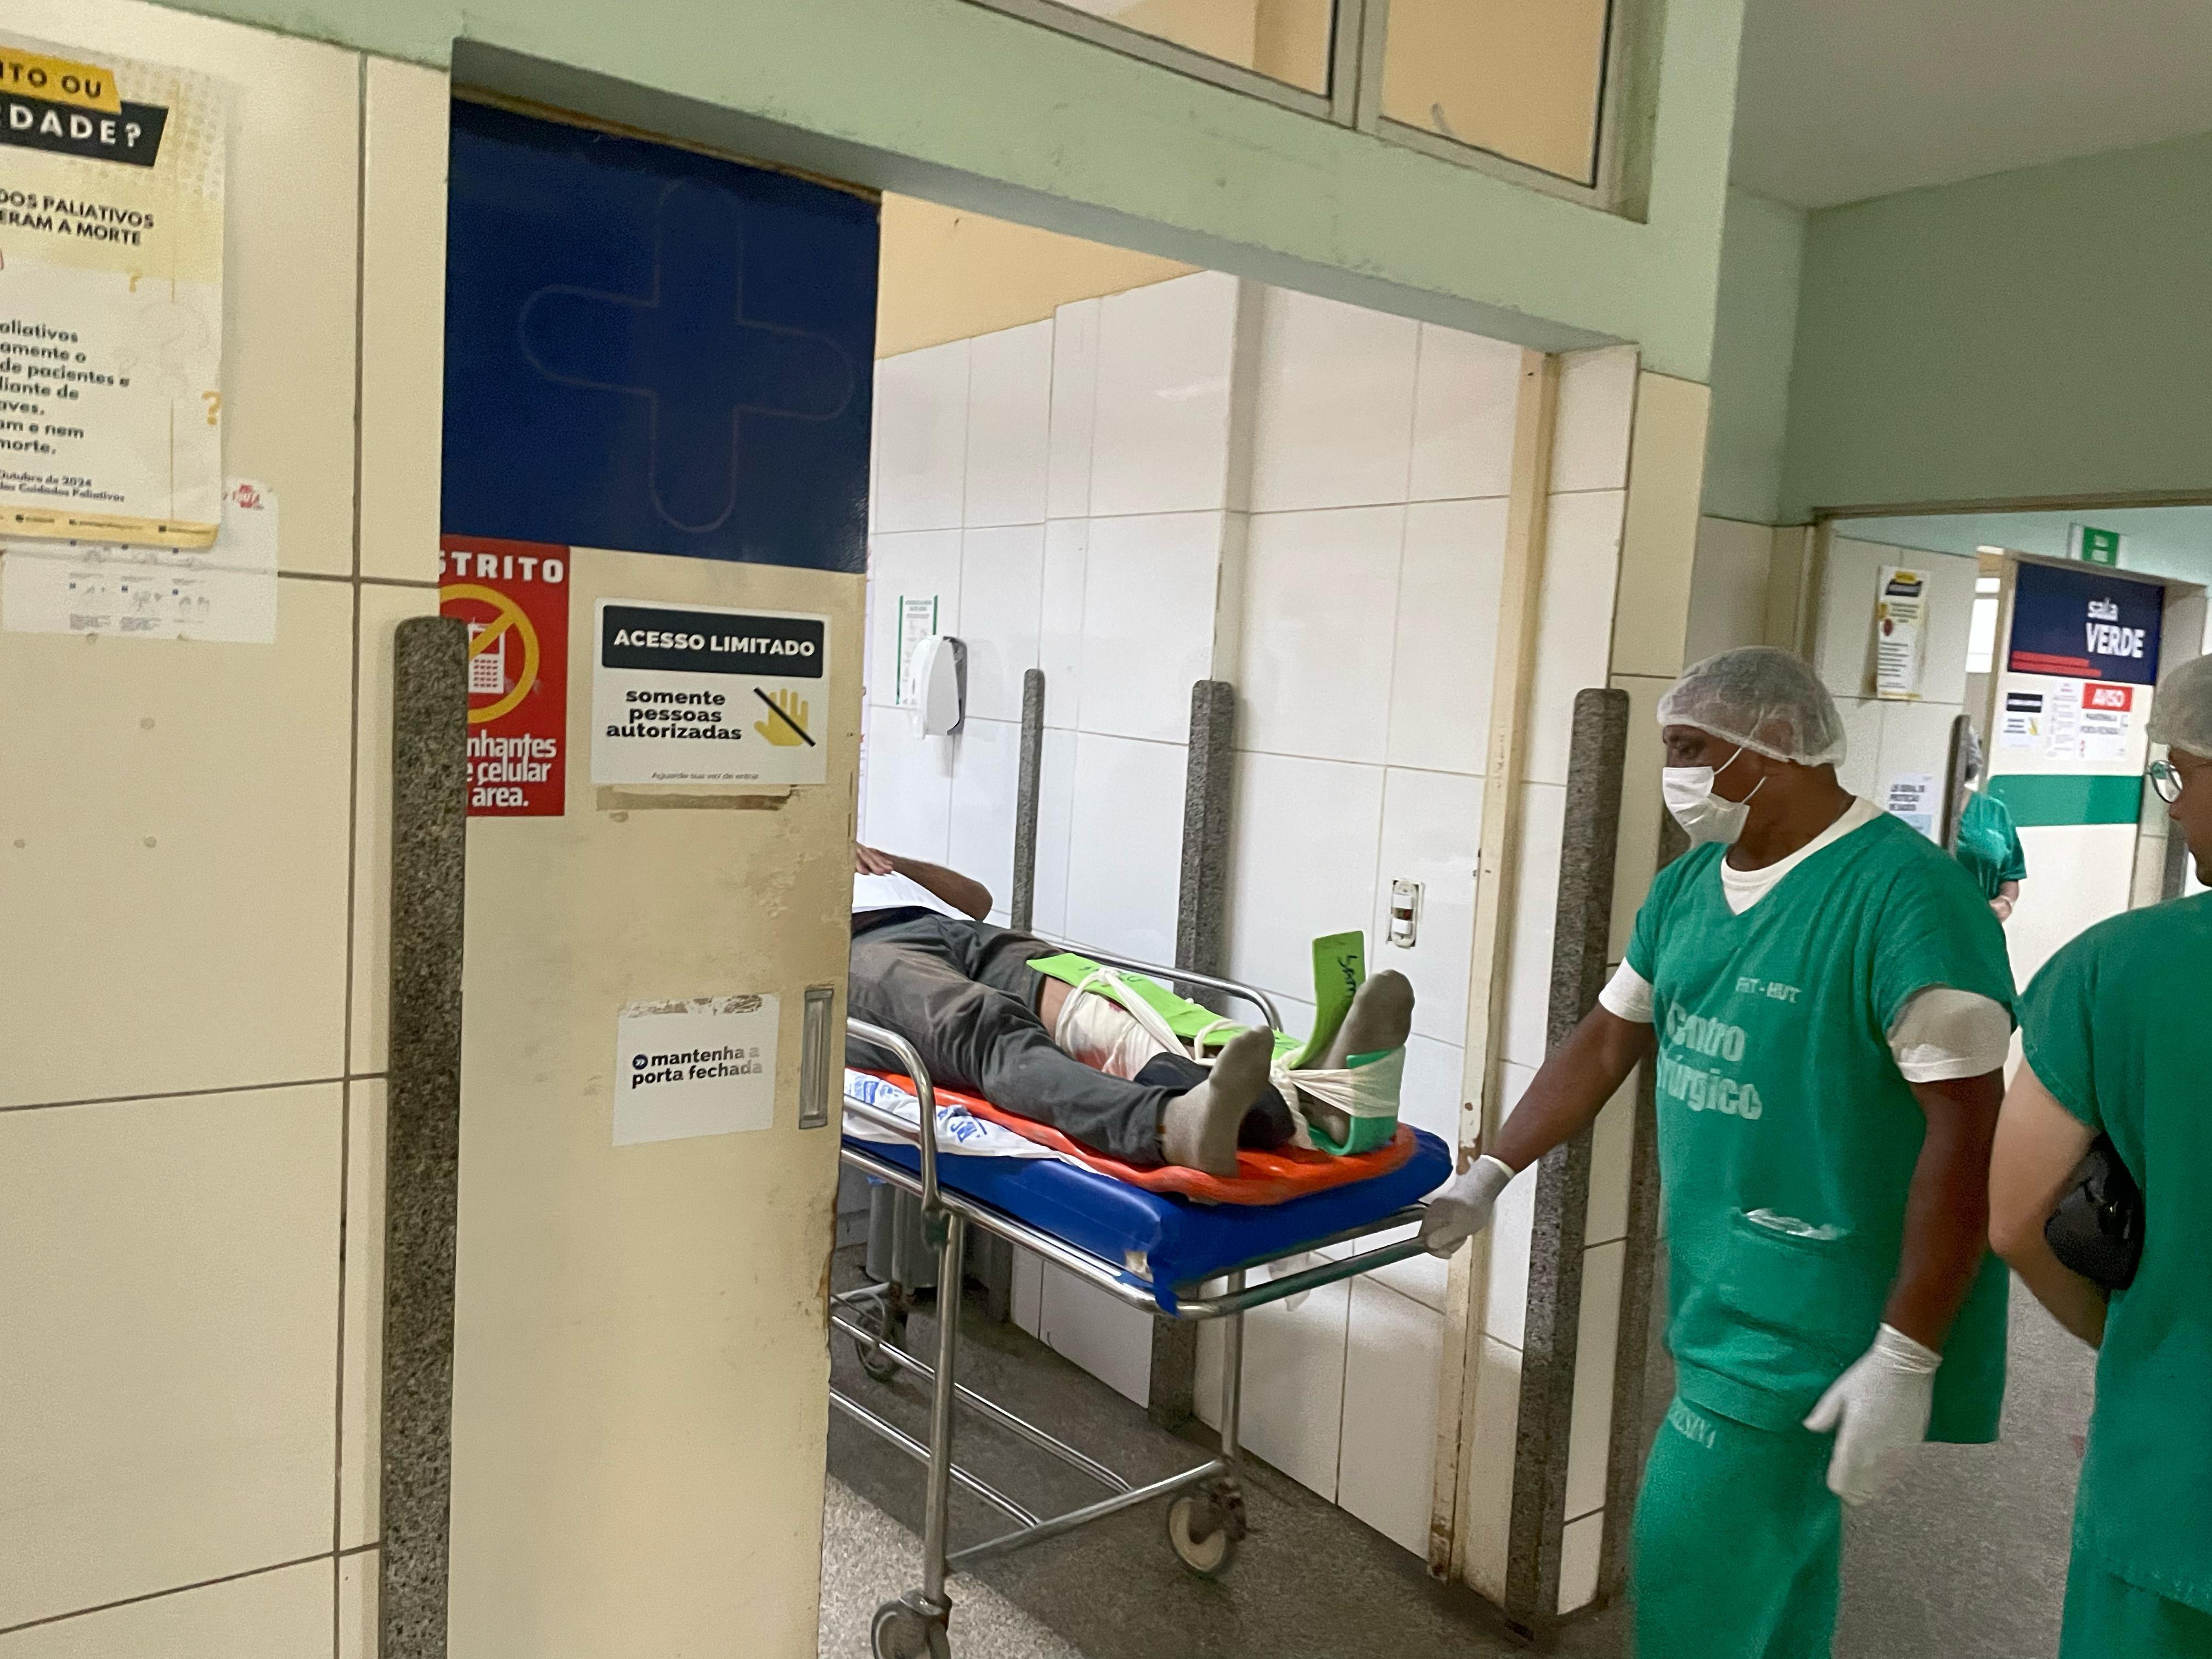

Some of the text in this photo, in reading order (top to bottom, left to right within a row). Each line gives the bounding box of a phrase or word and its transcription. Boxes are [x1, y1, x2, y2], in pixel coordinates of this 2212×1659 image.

[0, 60, 101, 98] TO OU
[10, 103, 141, 148] DADE?
[43, 195, 154, 229] PALIATIVOS
[58, 219, 71, 234] A
[77, 221, 140, 246] MORTE
[0, 319, 78, 343] aliativos
[0, 342, 69, 361] amente
[28, 364, 114, 386] pacientes
[57, 383, 79, 400] de
[29, 423, 39, 433] e
[45, 425, 84, 438] nem
[19, 483, 69, 496] Cuidados
[72, 488, 125, 502] Paliativos
[46, 475, 59, 484] de
[62, 476, 92, 487] 2024
[613, 629, 815, 657] ACESSO LIMITADO
[2086, 622, 2146, 658] VERDE
[626, 689, 725, 706] somente
[629, 708, 722, 724] pessoas
[607, 723, 742, 740] autorizadas
[467, 729, 556, 758] nhantes
[478, 755, 552, 783] celular
[651, 1046, 760, 1067] mantenha a
[632, 1060, 763, 1090] porta fechada
